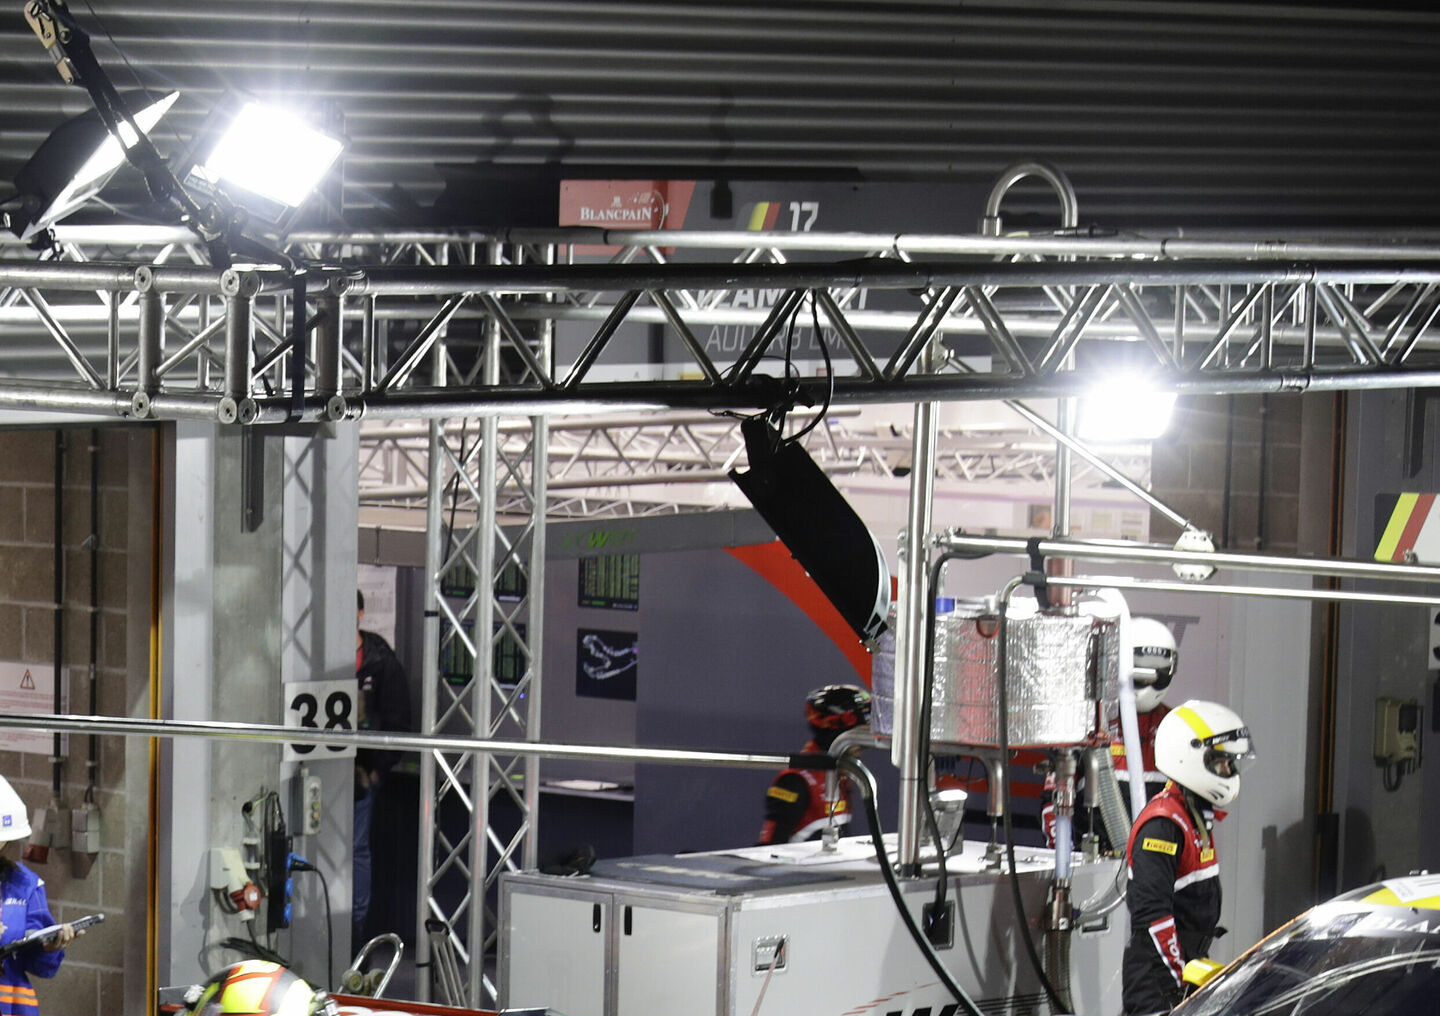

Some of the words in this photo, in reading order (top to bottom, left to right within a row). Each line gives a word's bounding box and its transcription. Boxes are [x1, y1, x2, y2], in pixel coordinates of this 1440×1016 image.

[580, 206, 652, 221] BLANCPAIN
[789, 202, 819, 232] 17
[290, 691, 352, 754] 38
